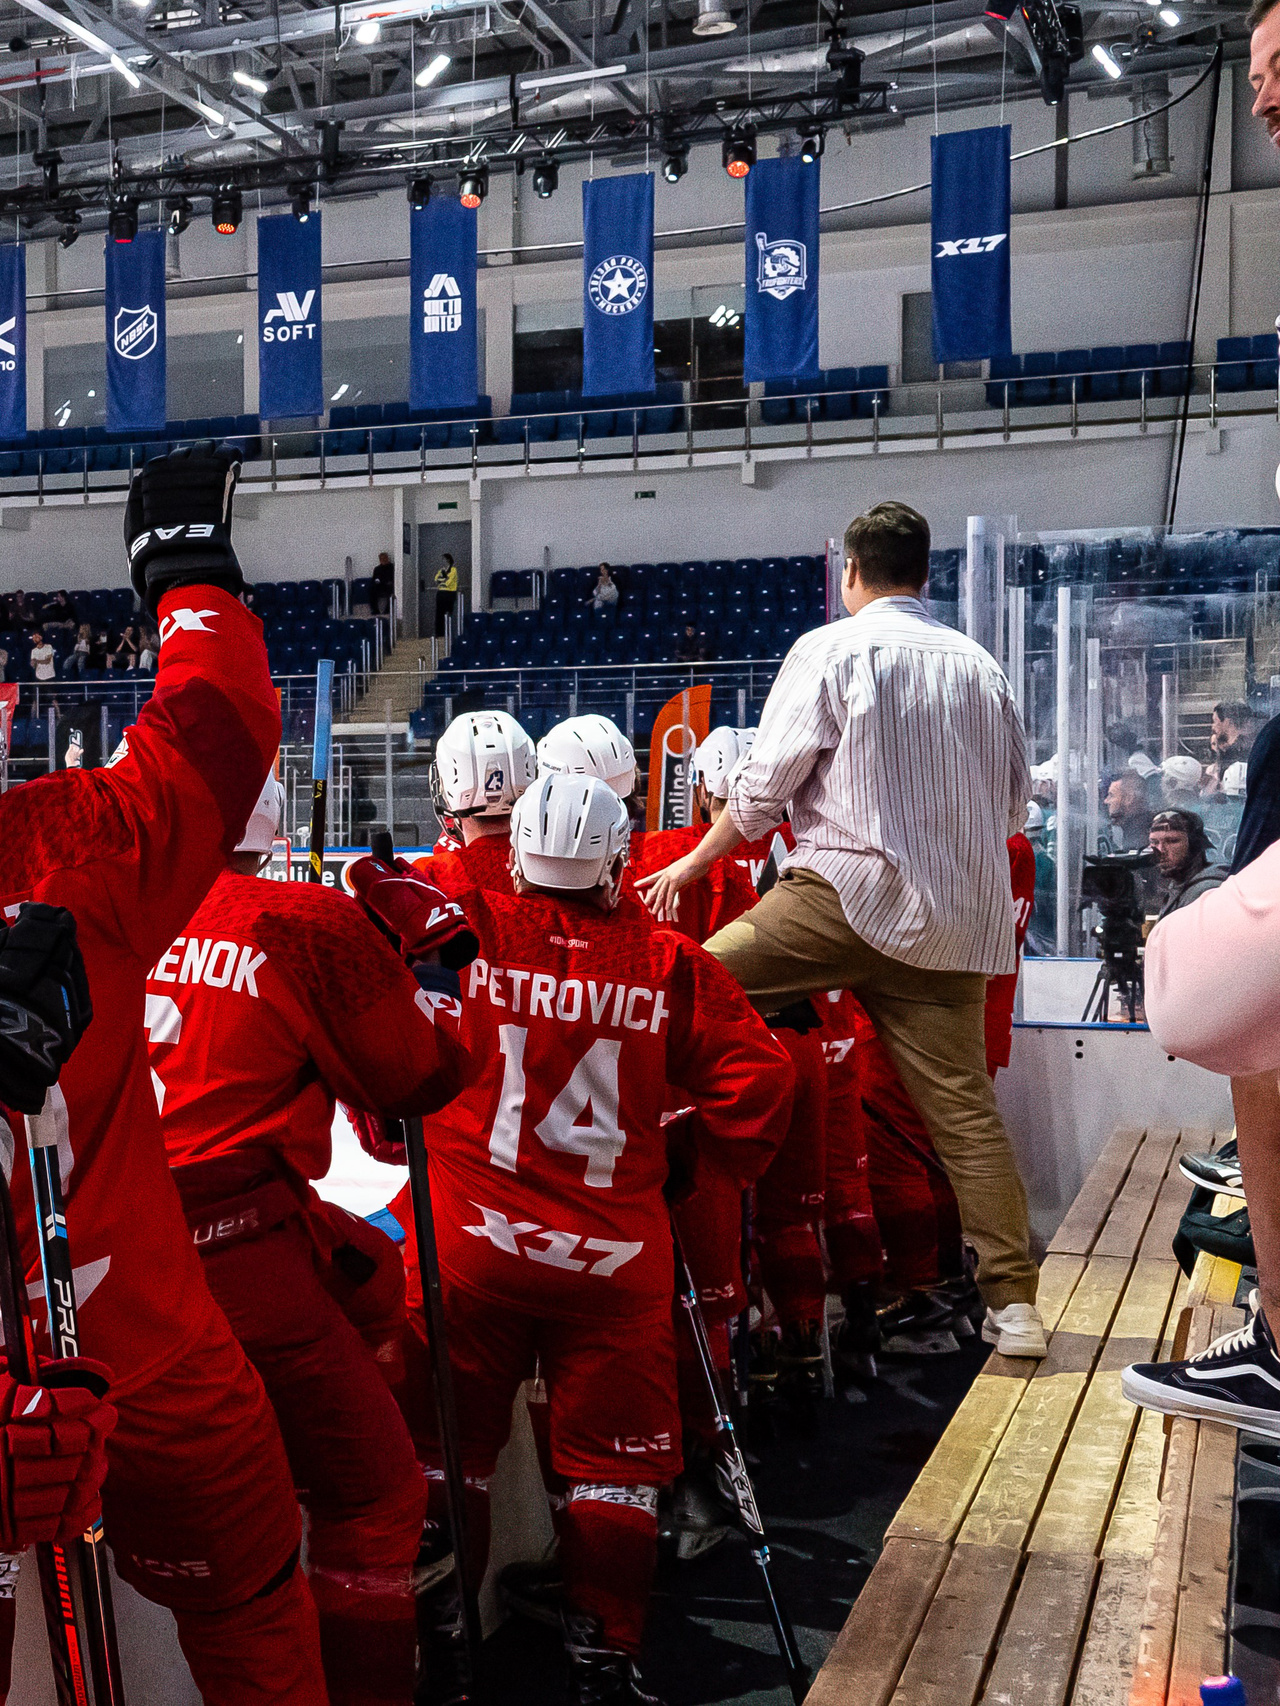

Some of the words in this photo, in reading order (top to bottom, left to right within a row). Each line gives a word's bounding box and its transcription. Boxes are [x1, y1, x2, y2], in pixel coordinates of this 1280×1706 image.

[935, 233, 1007, 258] X17
[263, 323, 316, 342] SOFT
[0, 360, 16, 371] 10
[667, 763, 686, 829] inline
[146, 936, 268, 998] ENOK
[489, 1023, 627, 1189] 14
[461, 1200, 644, 1277] X17
